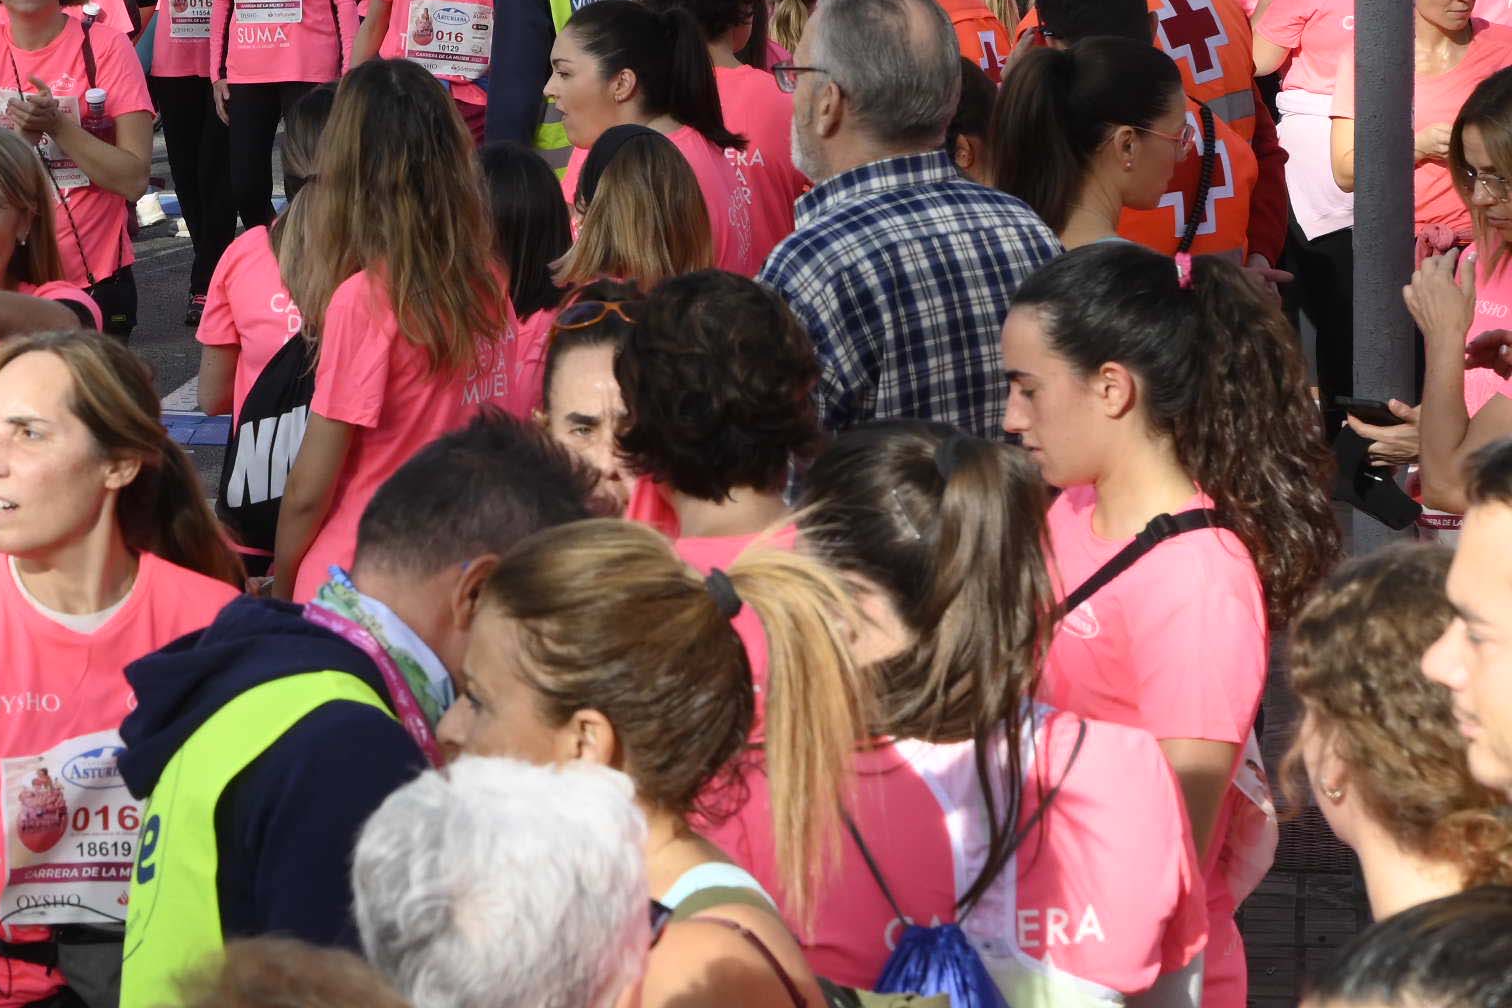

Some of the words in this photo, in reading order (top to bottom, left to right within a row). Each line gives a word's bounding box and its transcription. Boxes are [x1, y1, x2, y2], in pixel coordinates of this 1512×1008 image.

[237, 27, 286, 43] SUMA
[435, 30, 464, 42] 016
[72, 805, 139, 831] 016
[77, 841, 132, 858] 18619
[82, 867, 99, 878] DE
[102, 867, 117, 877] LA
[16, 893, 81, 911] OYSHO
